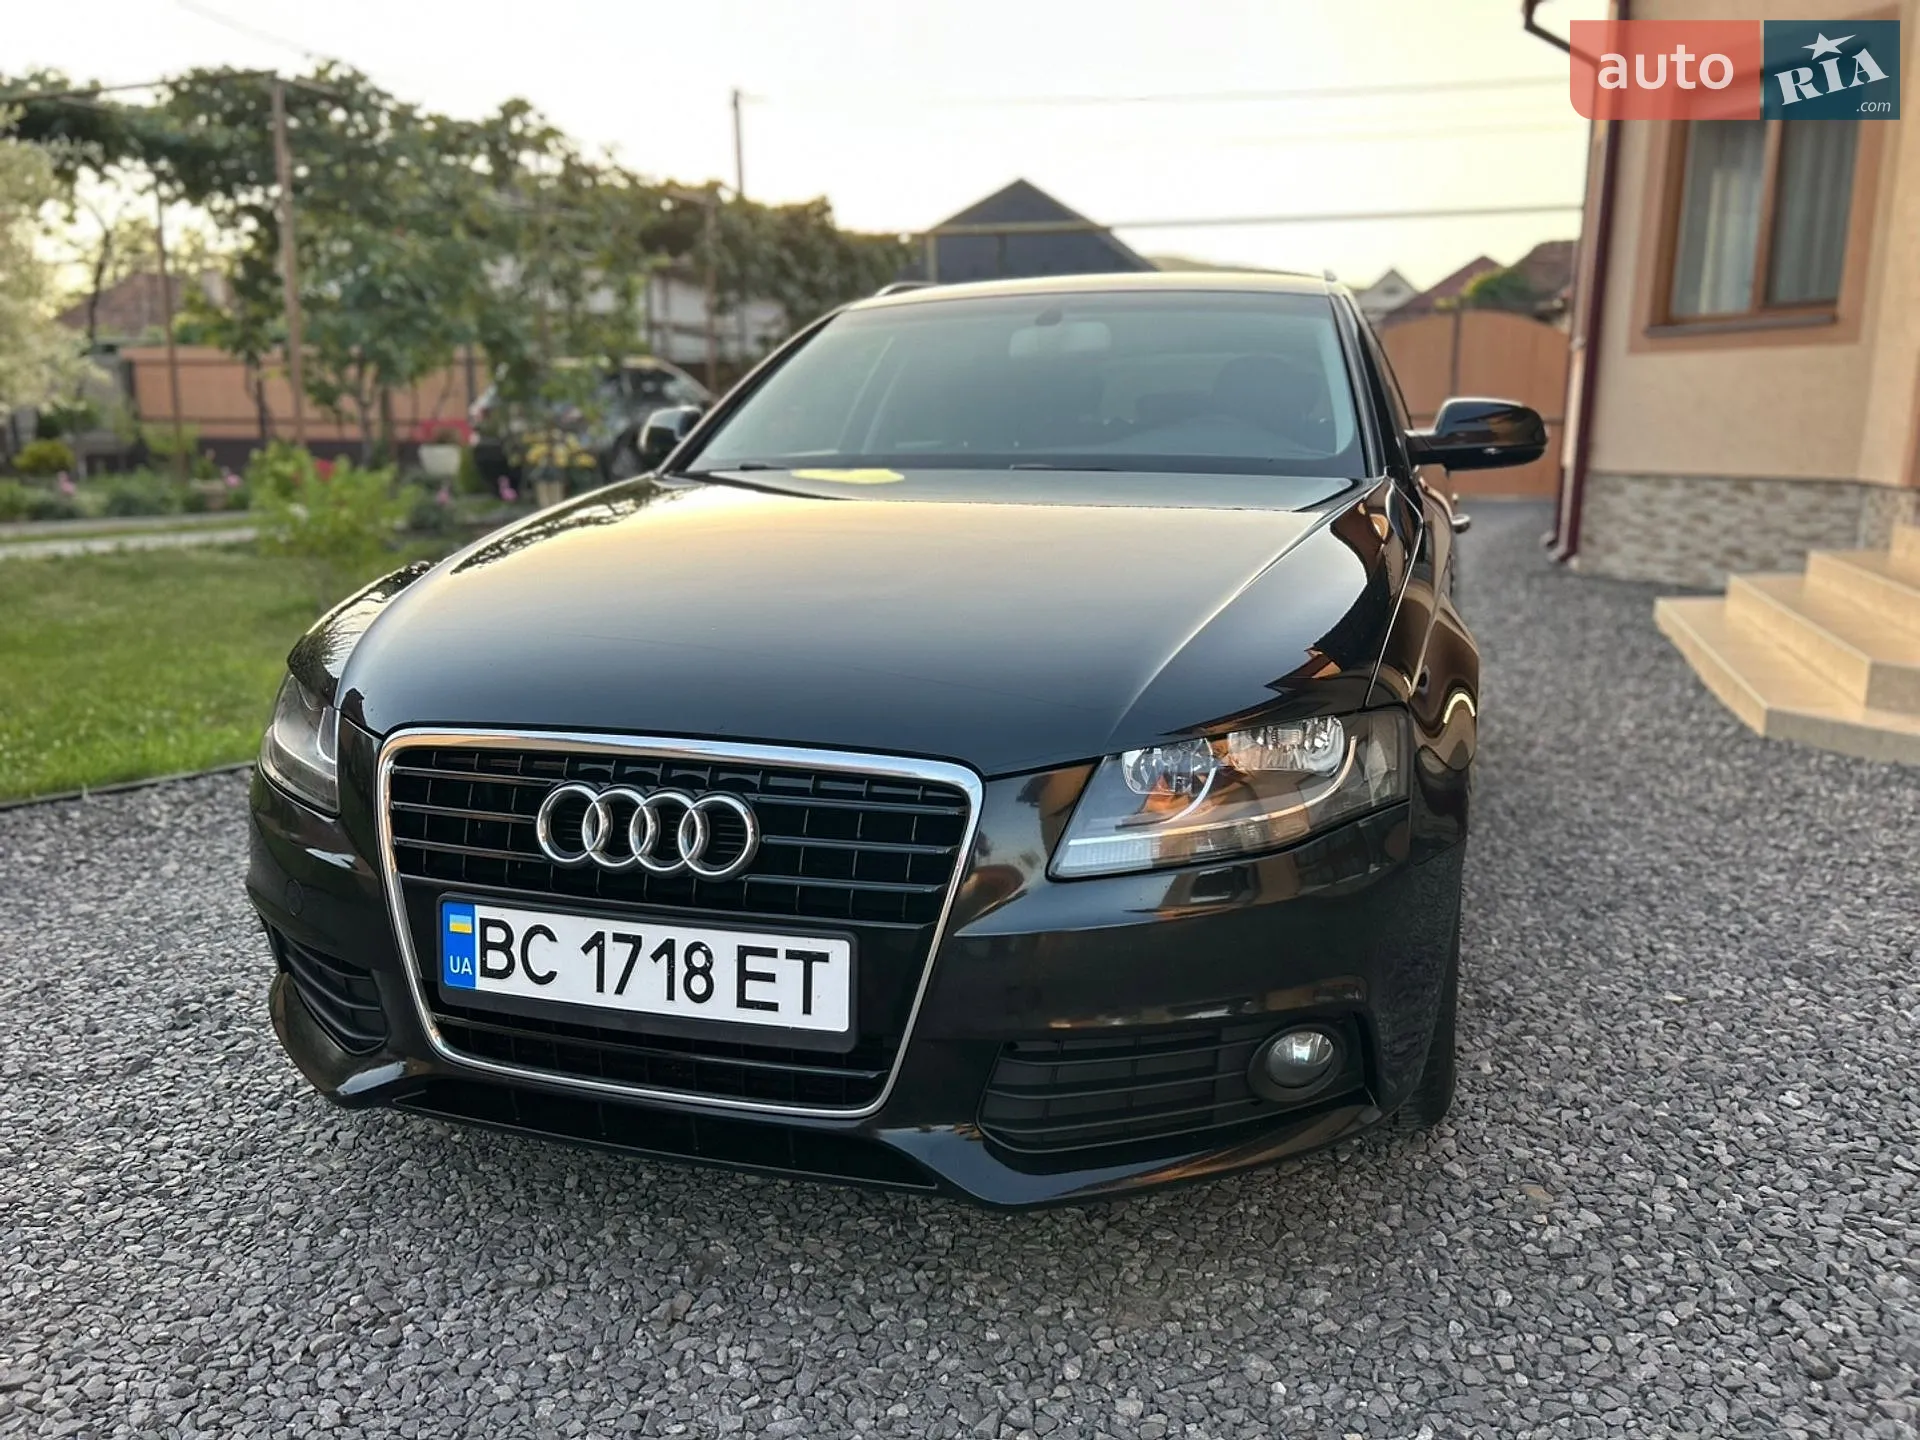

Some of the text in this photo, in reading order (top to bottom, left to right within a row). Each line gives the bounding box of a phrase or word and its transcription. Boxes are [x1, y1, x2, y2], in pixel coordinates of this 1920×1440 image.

[449, 956, 473, 976] UA
[479, 917, 831, 1016] BC 1718 ET
